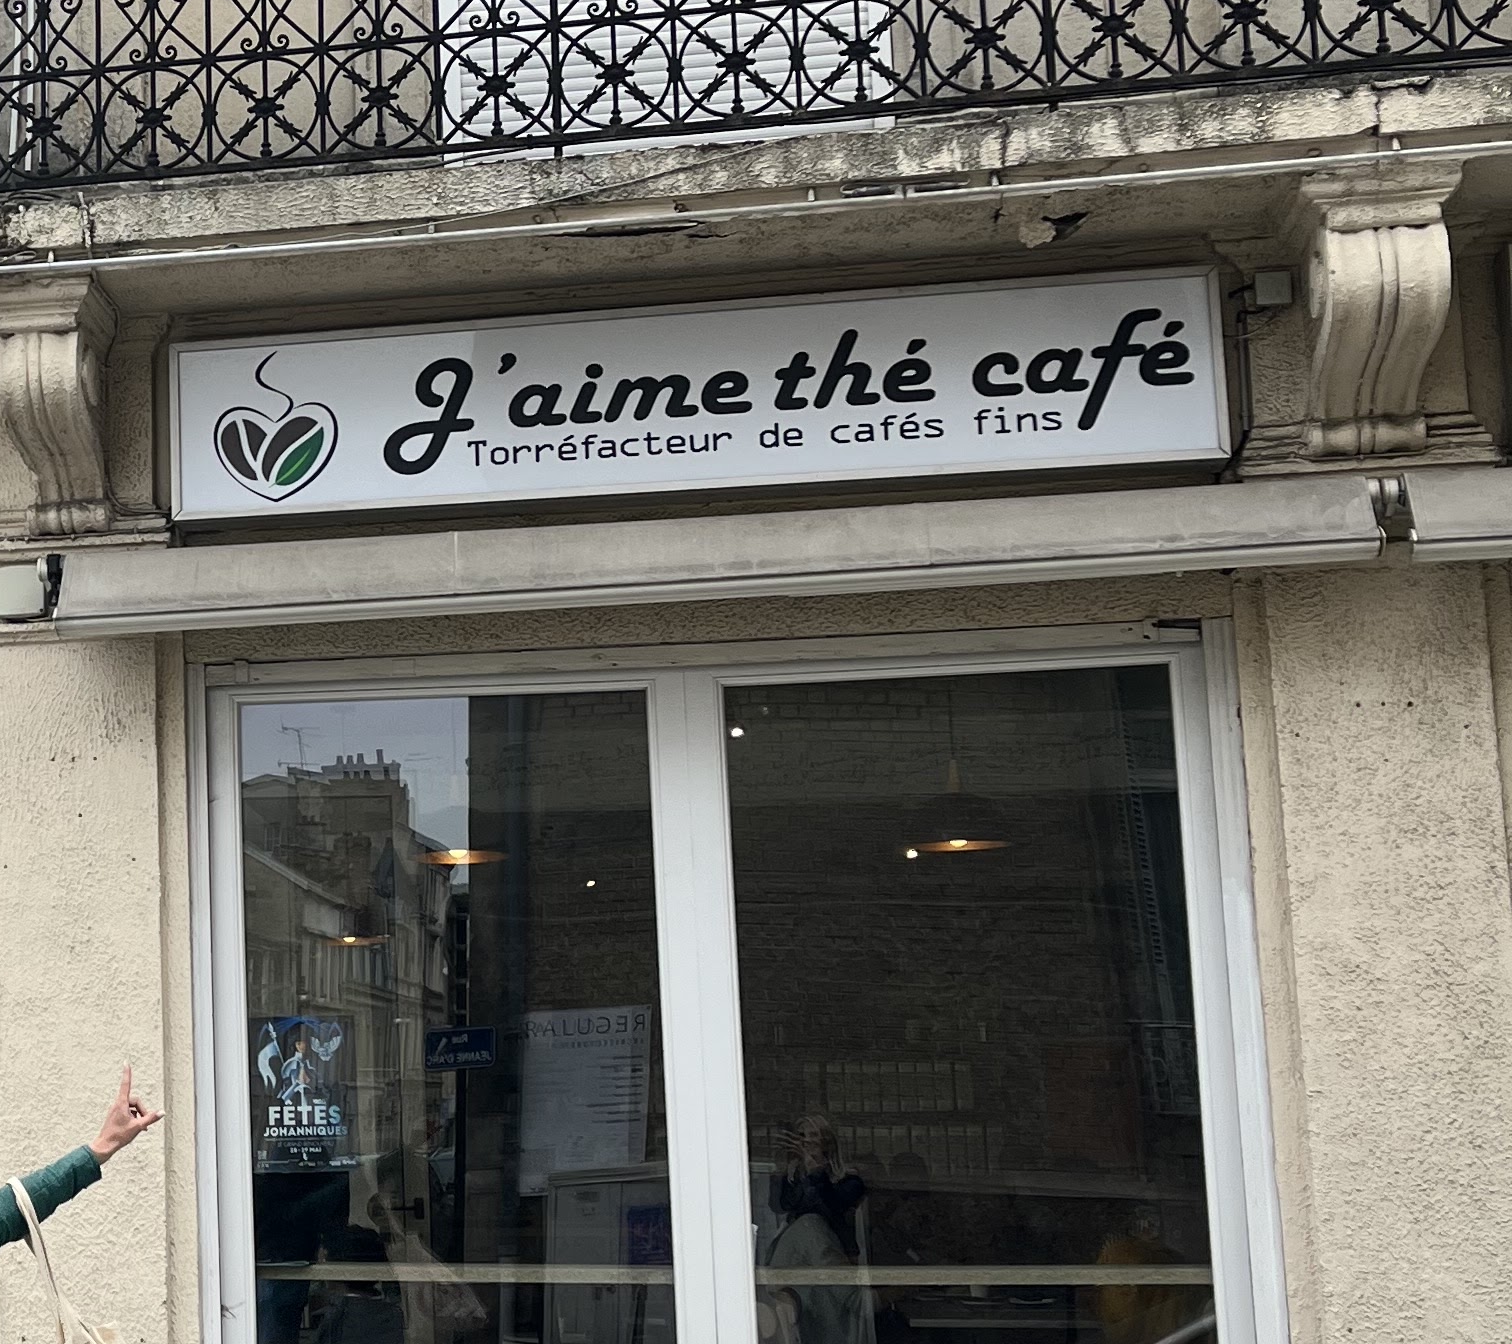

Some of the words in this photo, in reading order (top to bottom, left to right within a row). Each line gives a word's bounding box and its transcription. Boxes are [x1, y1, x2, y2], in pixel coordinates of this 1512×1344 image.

[383, 352, 753, 476] J'aime
[773, 328, 936, 411] thé
[971, 307, 1195, 431] café
[467, 431, 733, 467] Torréfacteur
[759, 422, 804, 449] de
[830, 414, 944, 444] cafés
[973, 408, 1062, 435] fins
[263, 1125, 349, 1137] JOHANNIQUES
[268, 1099, 341, 1125] FÊTES
